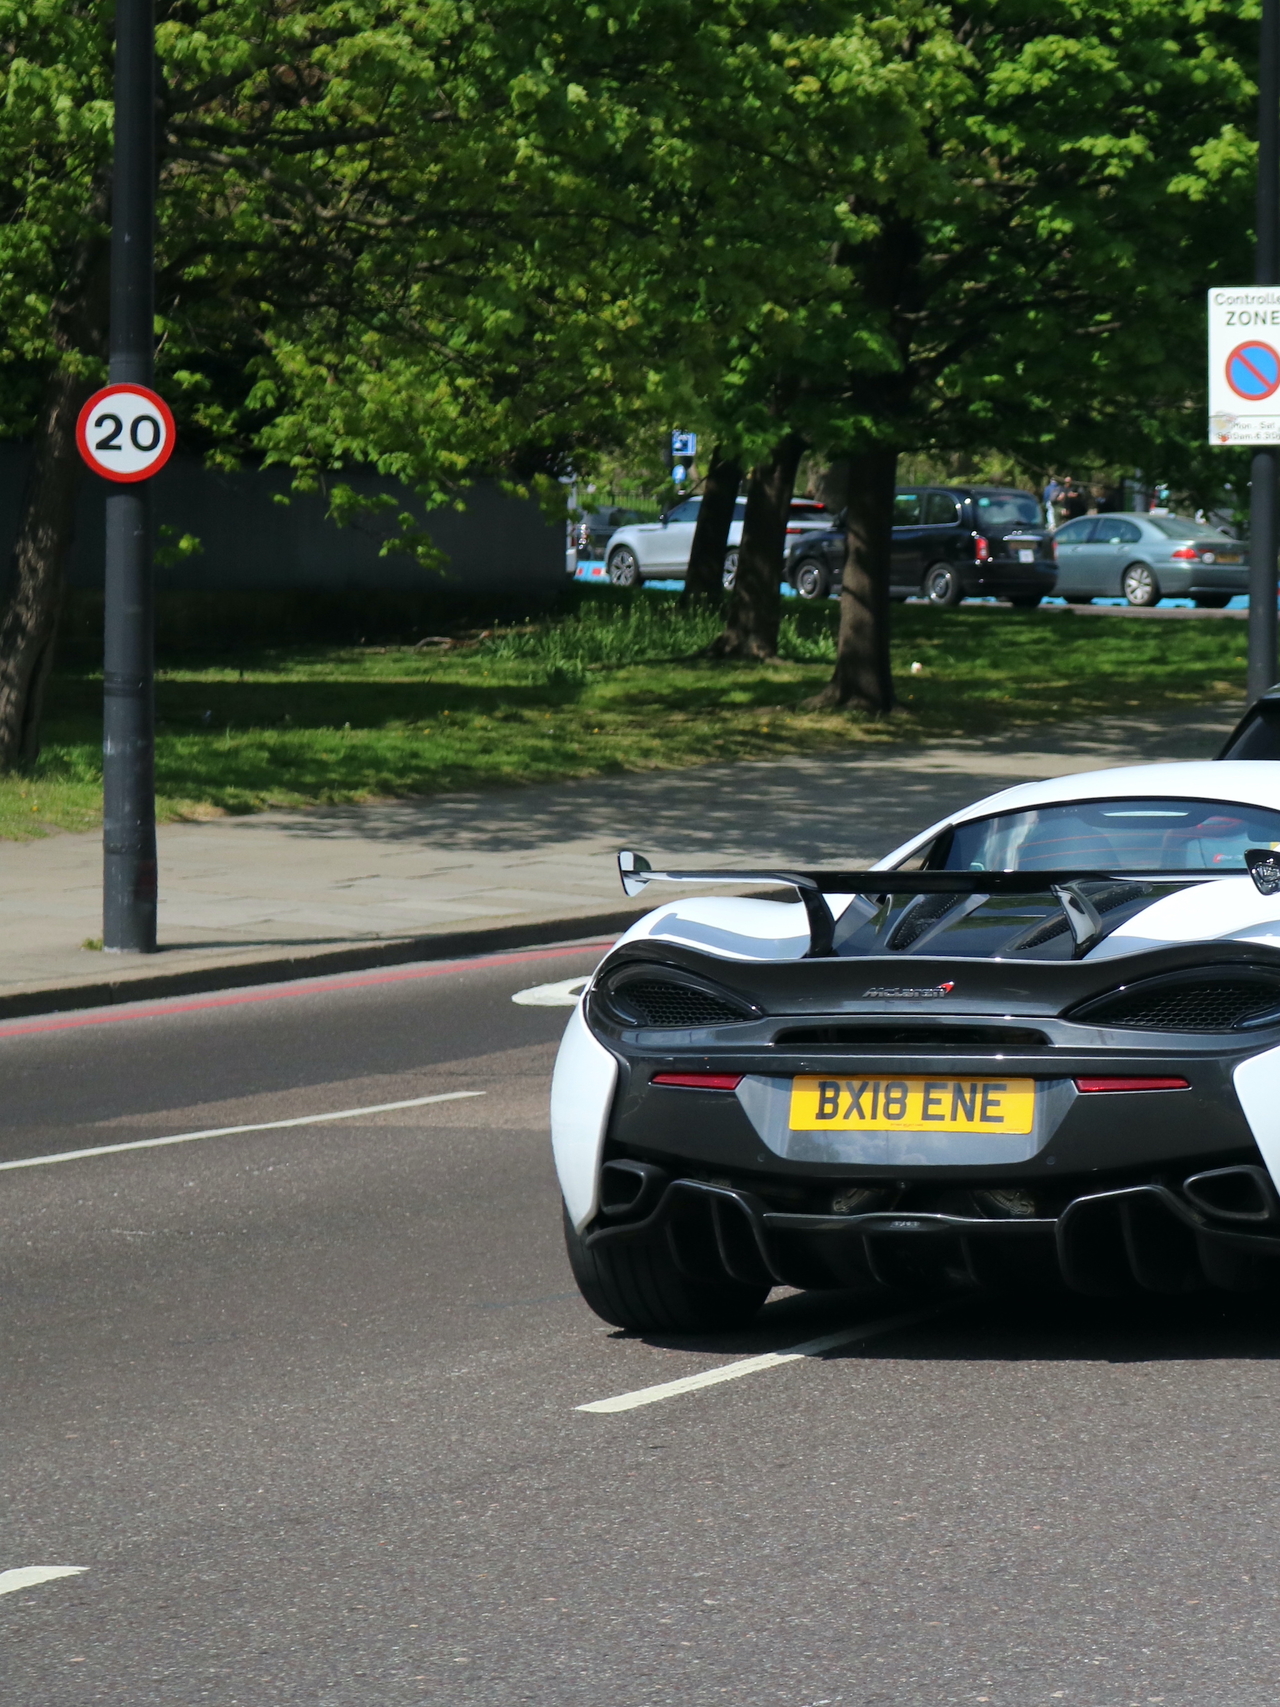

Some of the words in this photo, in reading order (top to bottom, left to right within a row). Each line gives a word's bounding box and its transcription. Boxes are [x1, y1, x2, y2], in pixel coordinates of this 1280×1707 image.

[93, 412, 161, 452] 20
[862, 986, 948, 998] McLaren
[814, 1080, 909, 1121] BX18
[920, 1081, 1007, 1123] ENE
